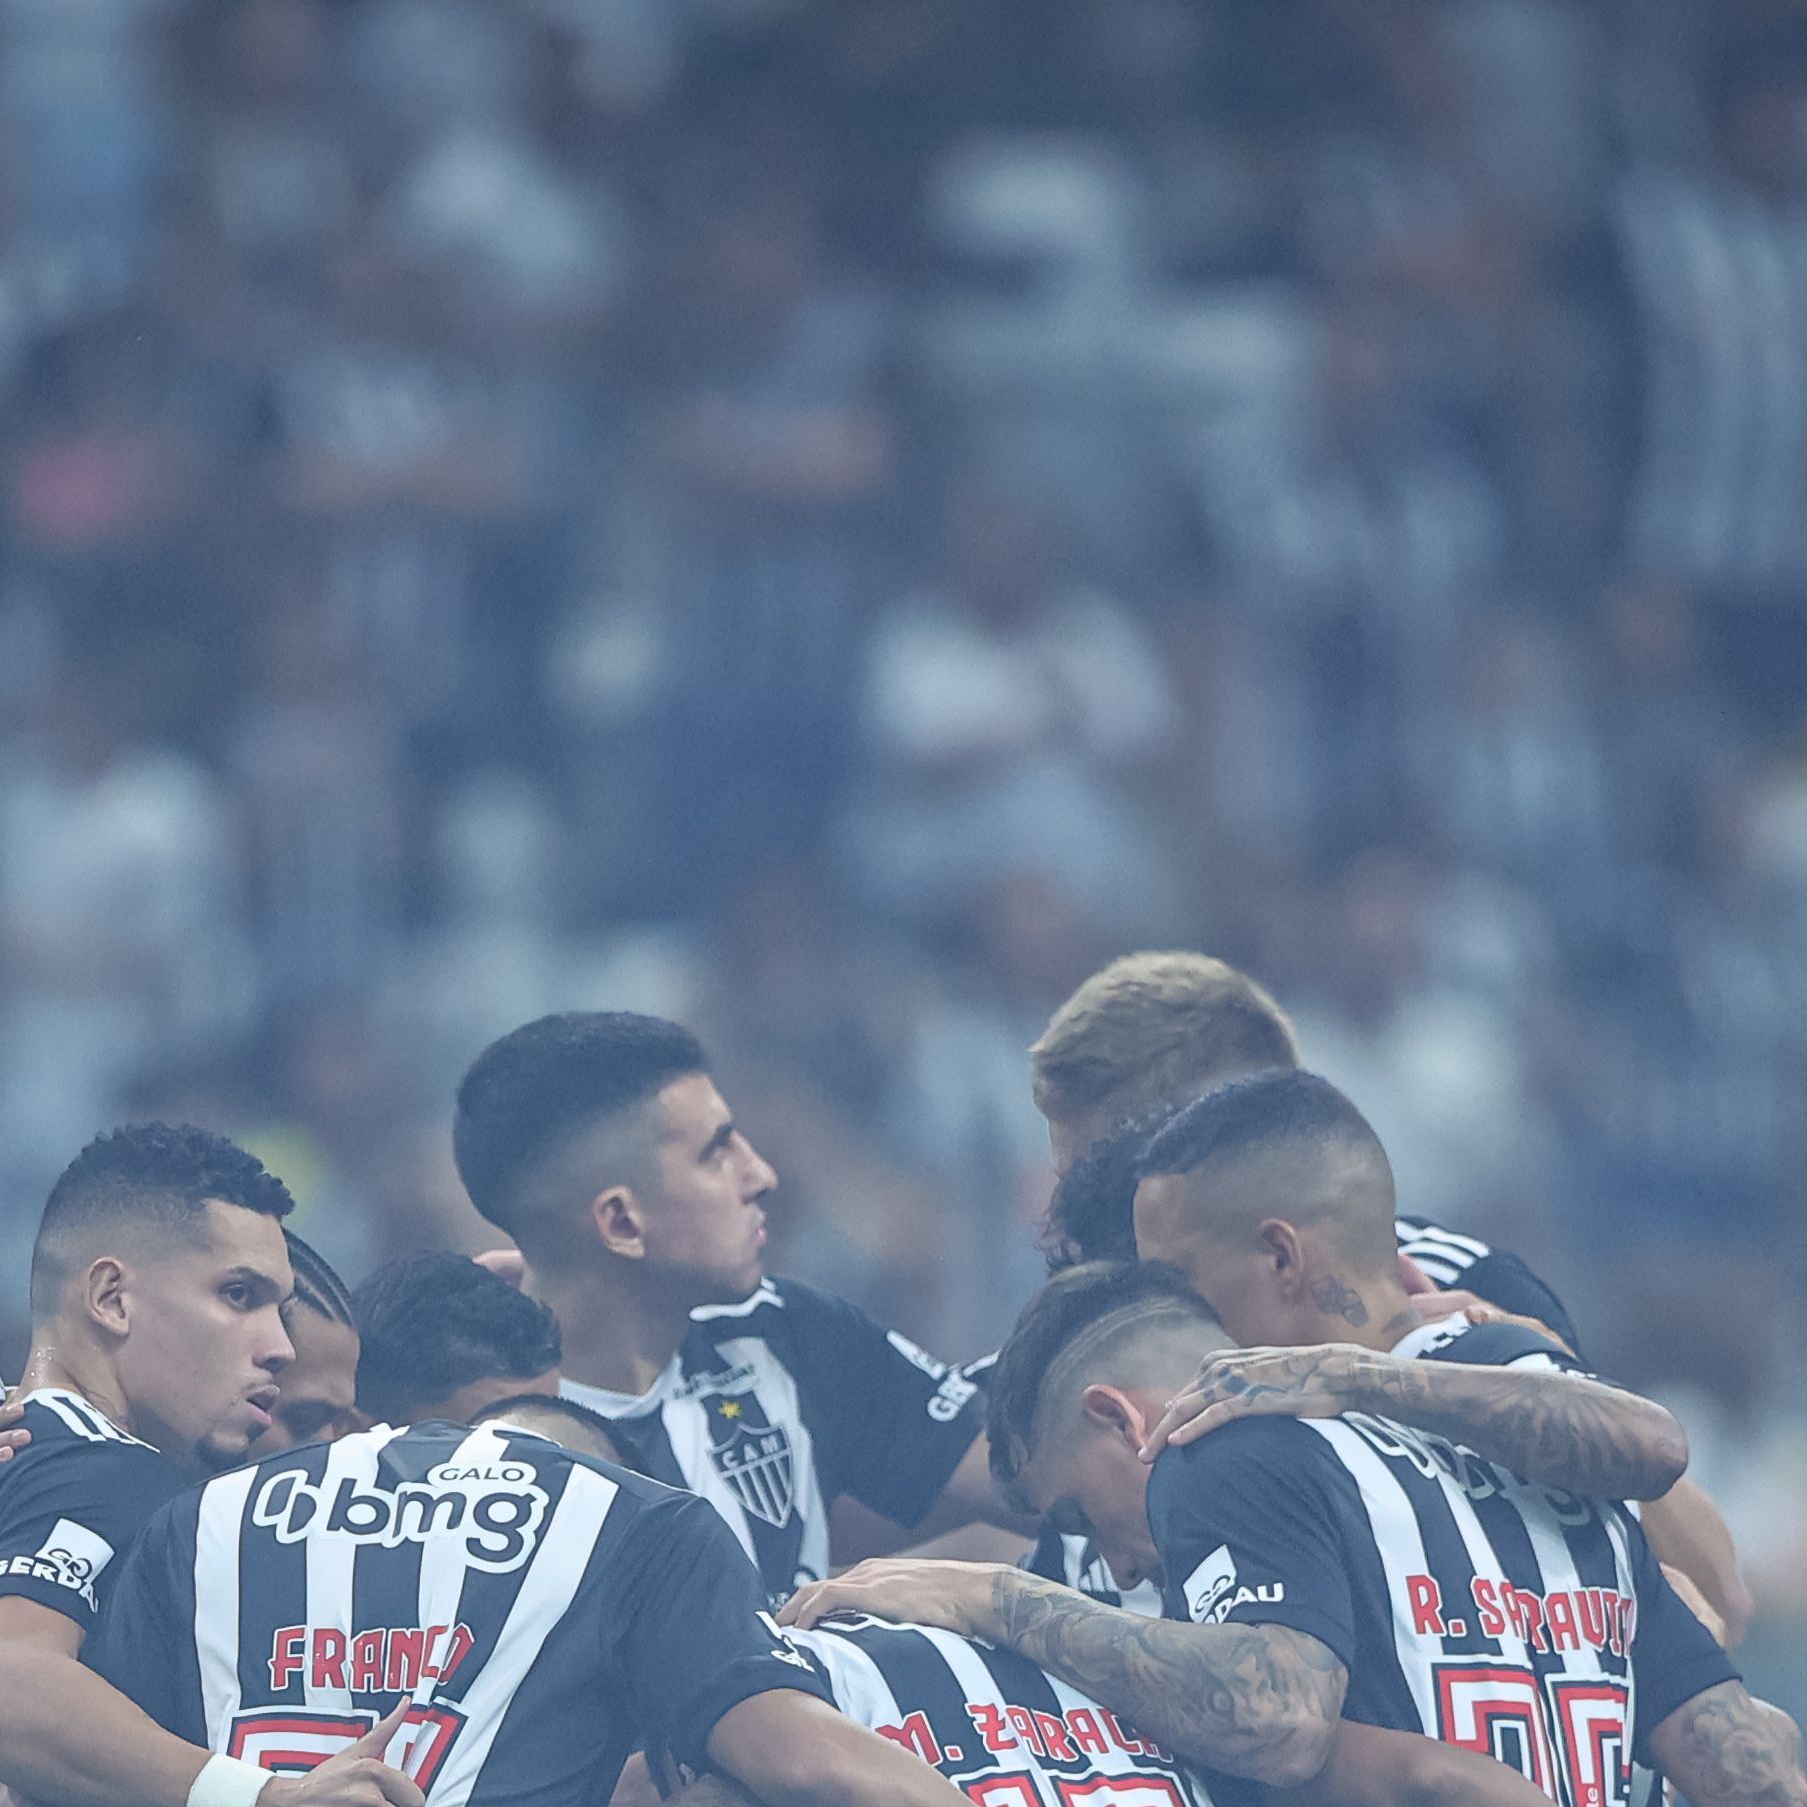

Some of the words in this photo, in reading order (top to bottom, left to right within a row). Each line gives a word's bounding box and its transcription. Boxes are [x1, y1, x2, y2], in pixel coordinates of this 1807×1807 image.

[438, 1466, 525, 1483] GALO
[720, 1434, 781, 1470] CAM
[325, 1477, 538, 1564] bmg
[1406, 1573, 1468, 1637] R.
[268, 1621, 477, 1694] FRANCO
[875, 1710, 963, 1768] M.
